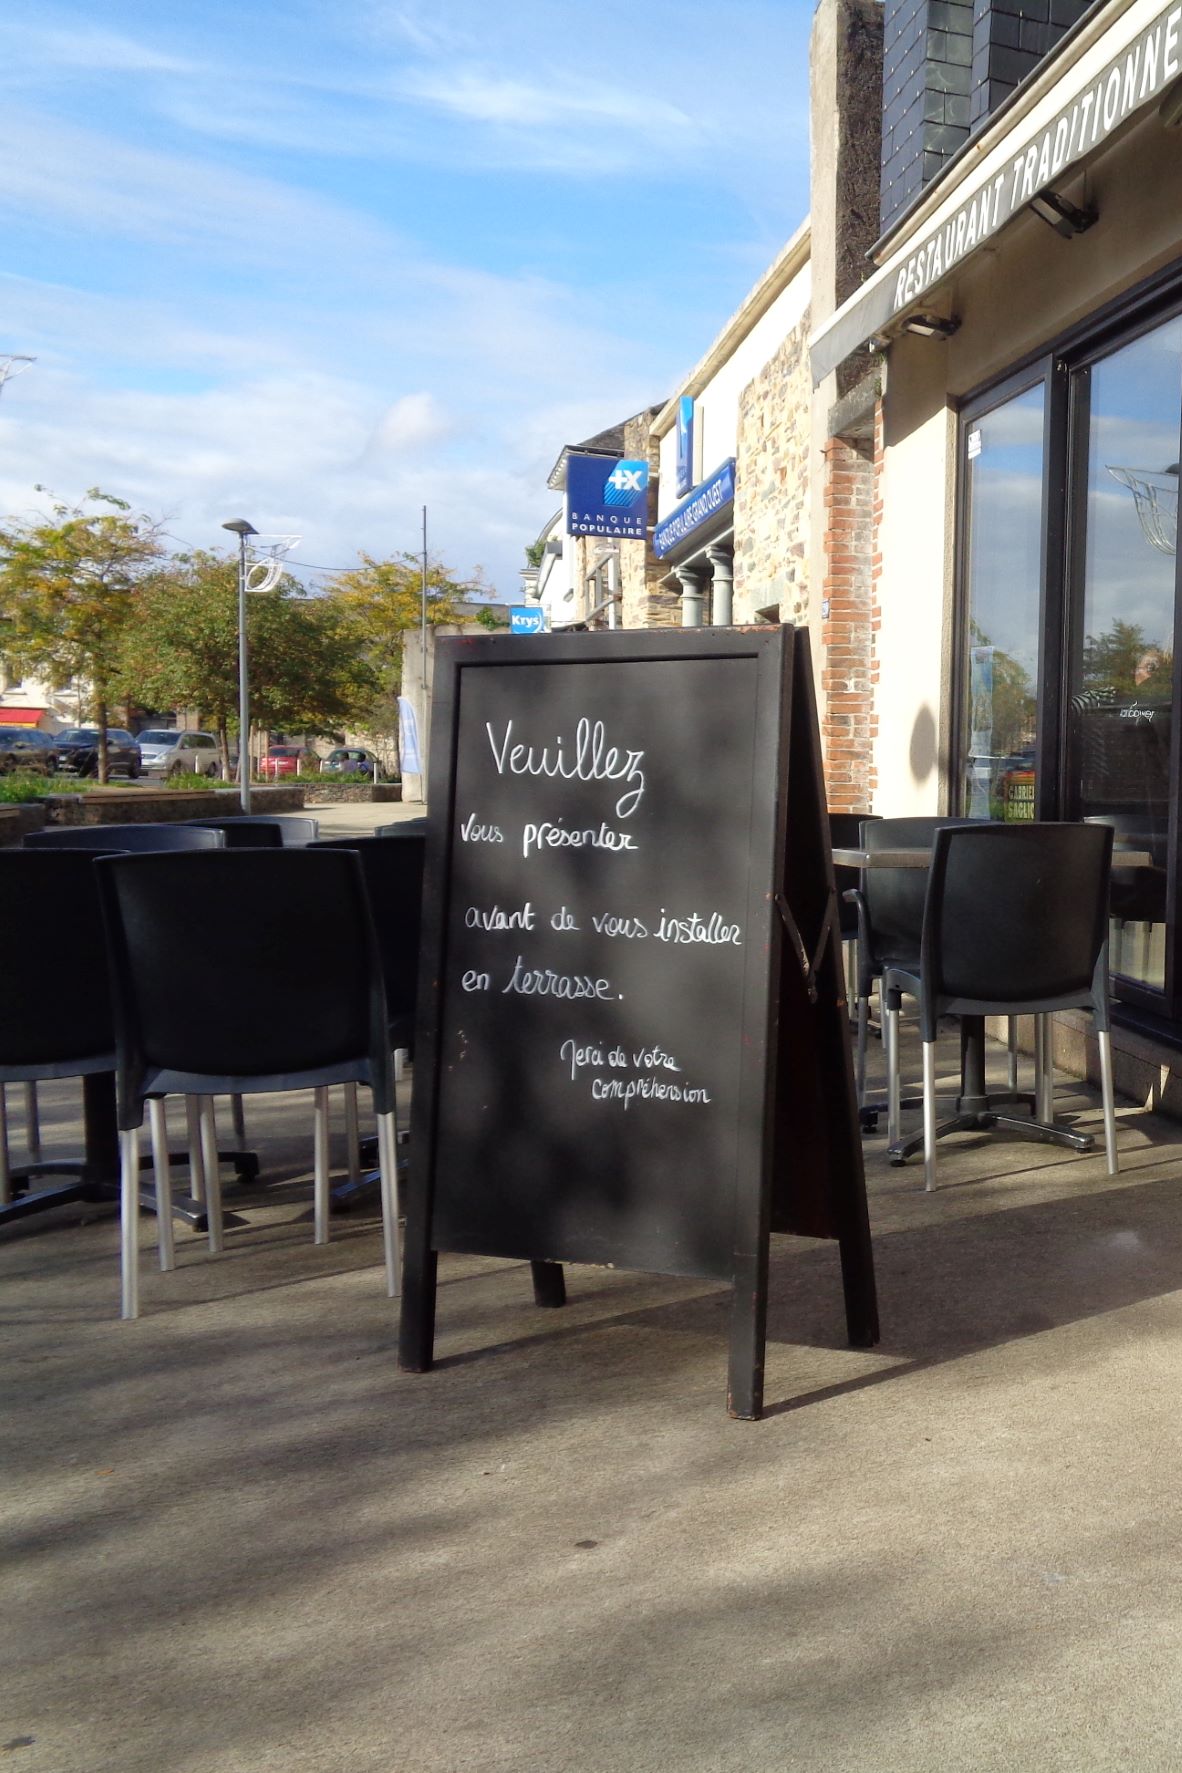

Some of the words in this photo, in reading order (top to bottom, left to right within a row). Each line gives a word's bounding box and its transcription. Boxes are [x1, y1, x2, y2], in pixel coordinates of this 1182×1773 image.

[893, 177, 1005, 311] RESTAURANT
[572, 512, 642, 525] BANQUE
[572, 522, 642, 535] POPULAIRE
[512, 615, 539, 628] Krys
[486, 717, 645, 818] Veuillez
[523, 817, 638, 858] présenter
[465, 902, 535, 932] avant
[551, 906, 580, 931] de
[592, 912, 648, 938] vous
[653, 908, 742, 945] installer
[461, 970, 489, 993] en
[608, 1046, 627, 1070] de
[633, 1044, 683, 1073] votre
[592, 1076, 711, 1111] compréhension
